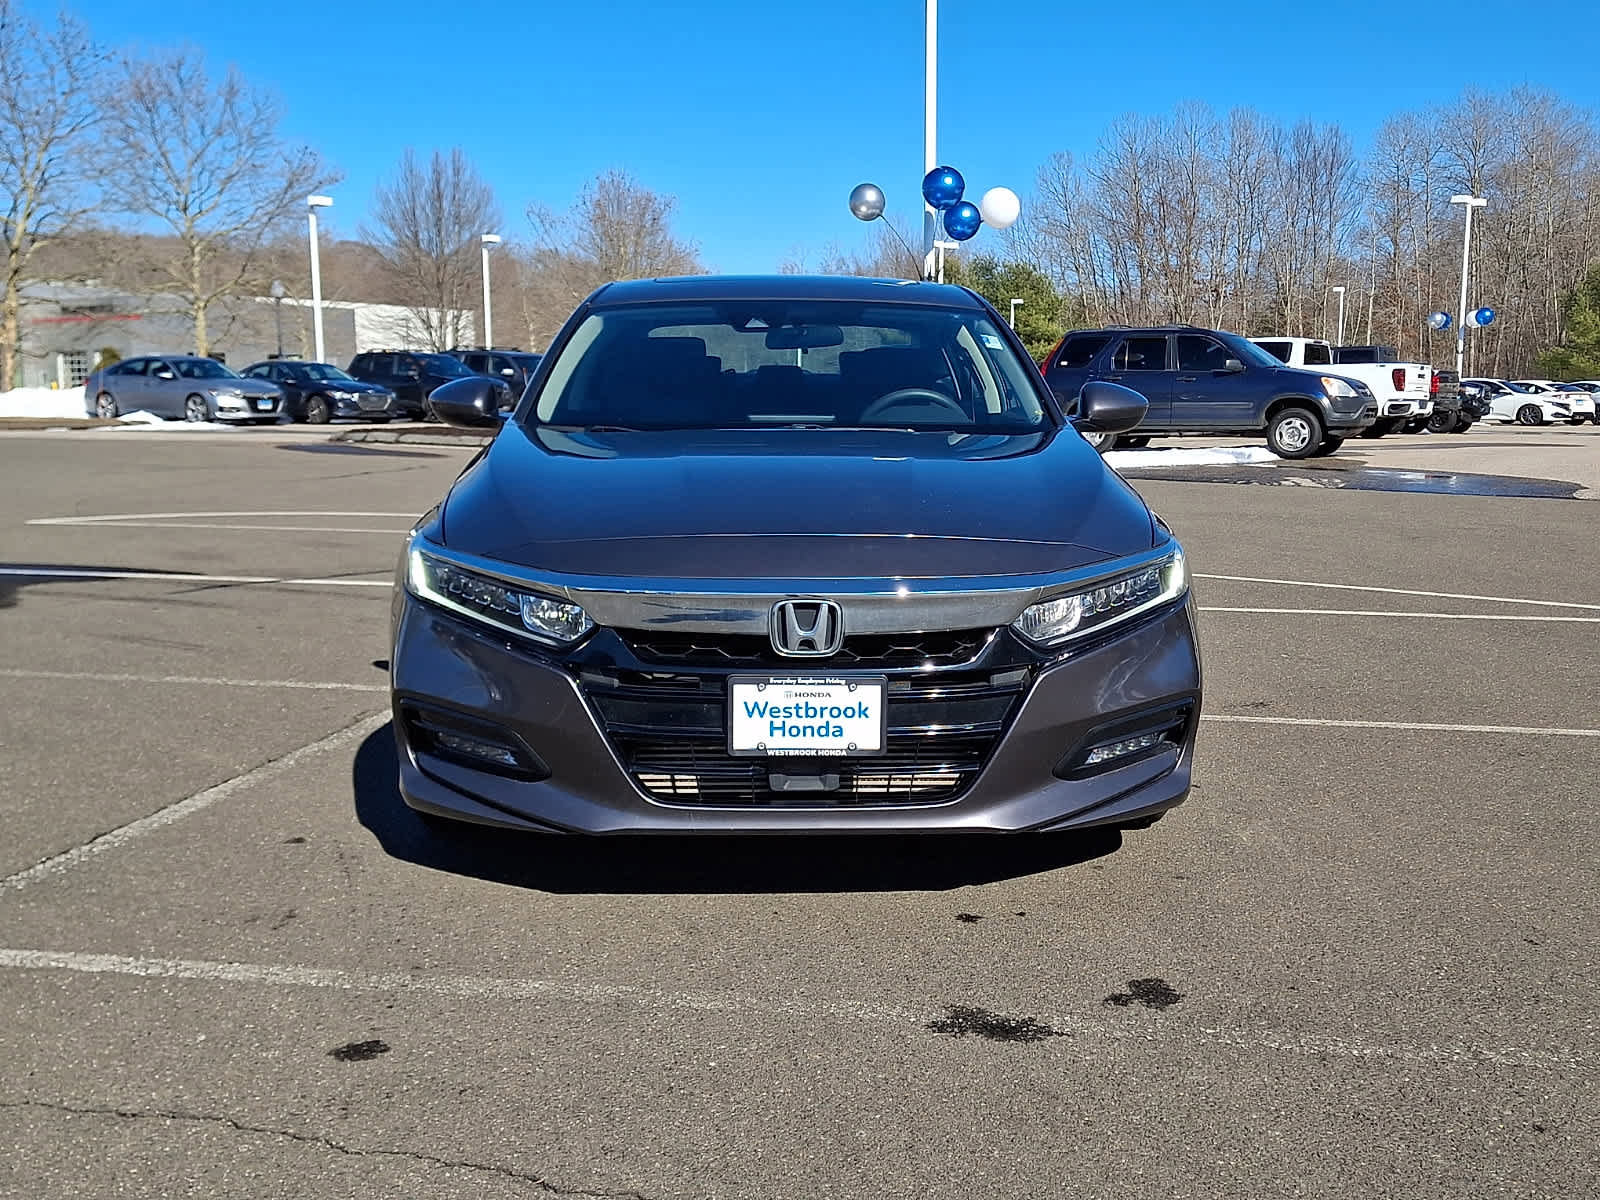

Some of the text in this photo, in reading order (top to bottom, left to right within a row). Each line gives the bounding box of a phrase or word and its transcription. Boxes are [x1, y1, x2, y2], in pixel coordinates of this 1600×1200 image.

[744, 701, 869, 718] Westbrook
[769, 720, 844, 737] Honda
[767, 749, 848, 757] WESTBROOK HONDA
